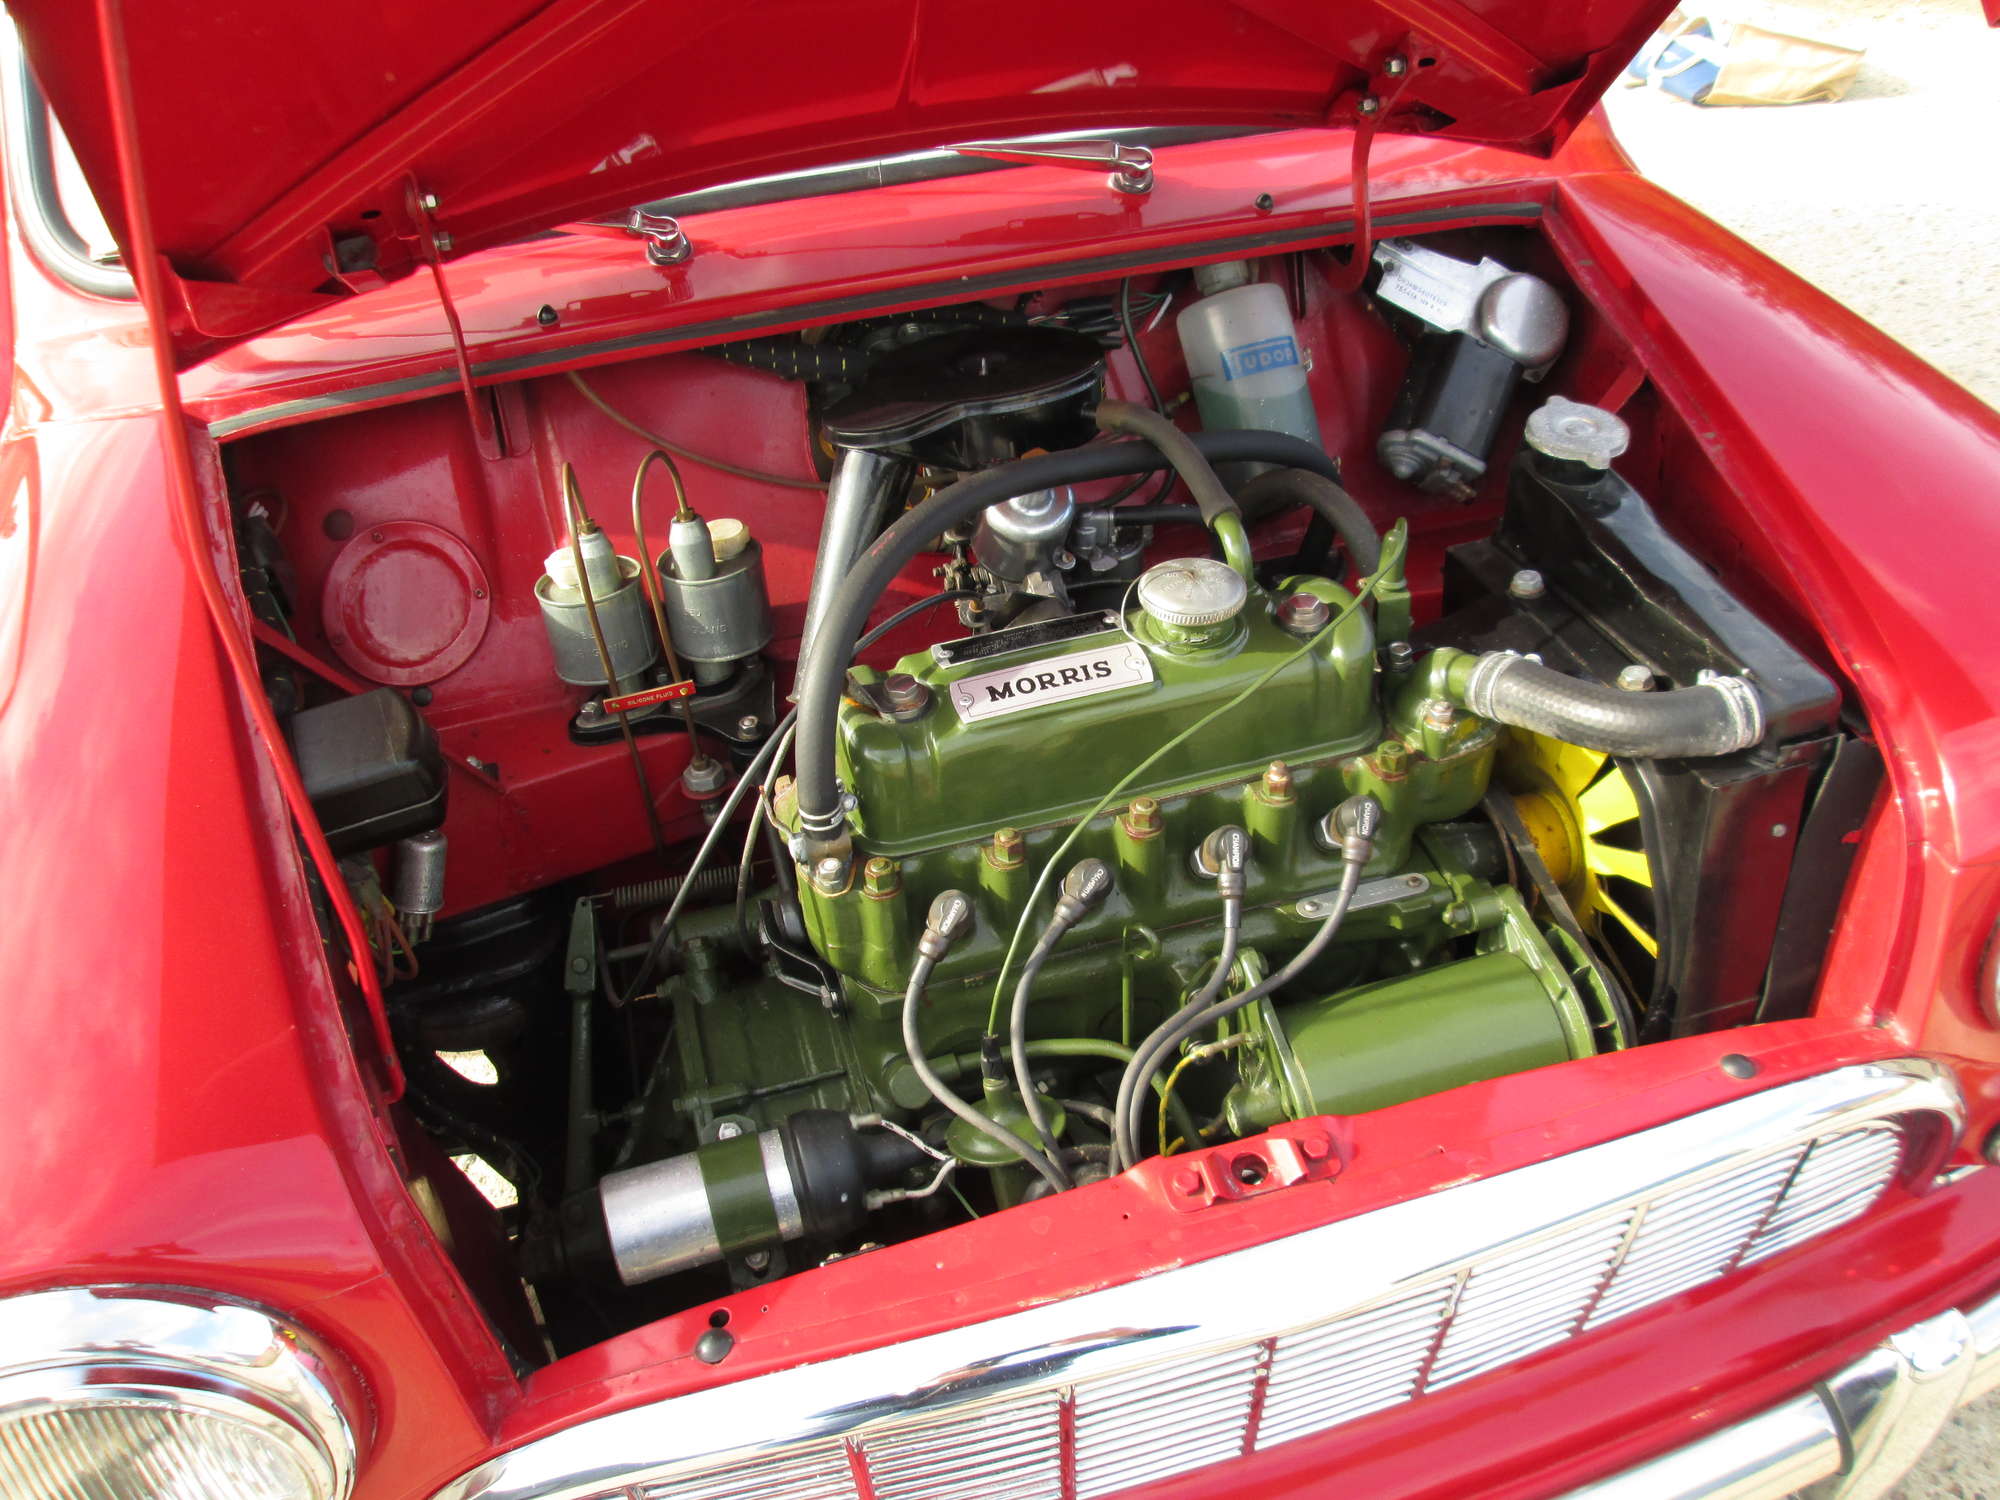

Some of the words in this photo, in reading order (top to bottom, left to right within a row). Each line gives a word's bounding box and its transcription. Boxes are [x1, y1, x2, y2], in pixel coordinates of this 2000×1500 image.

[986, 660, 1112, 703] MORRIS
[1362, 802, 1372, 836] CHAMPION
[1231, 832, 1240, 869] CHAMPION
[1080, 868, 1104, 898] CHAMPION
